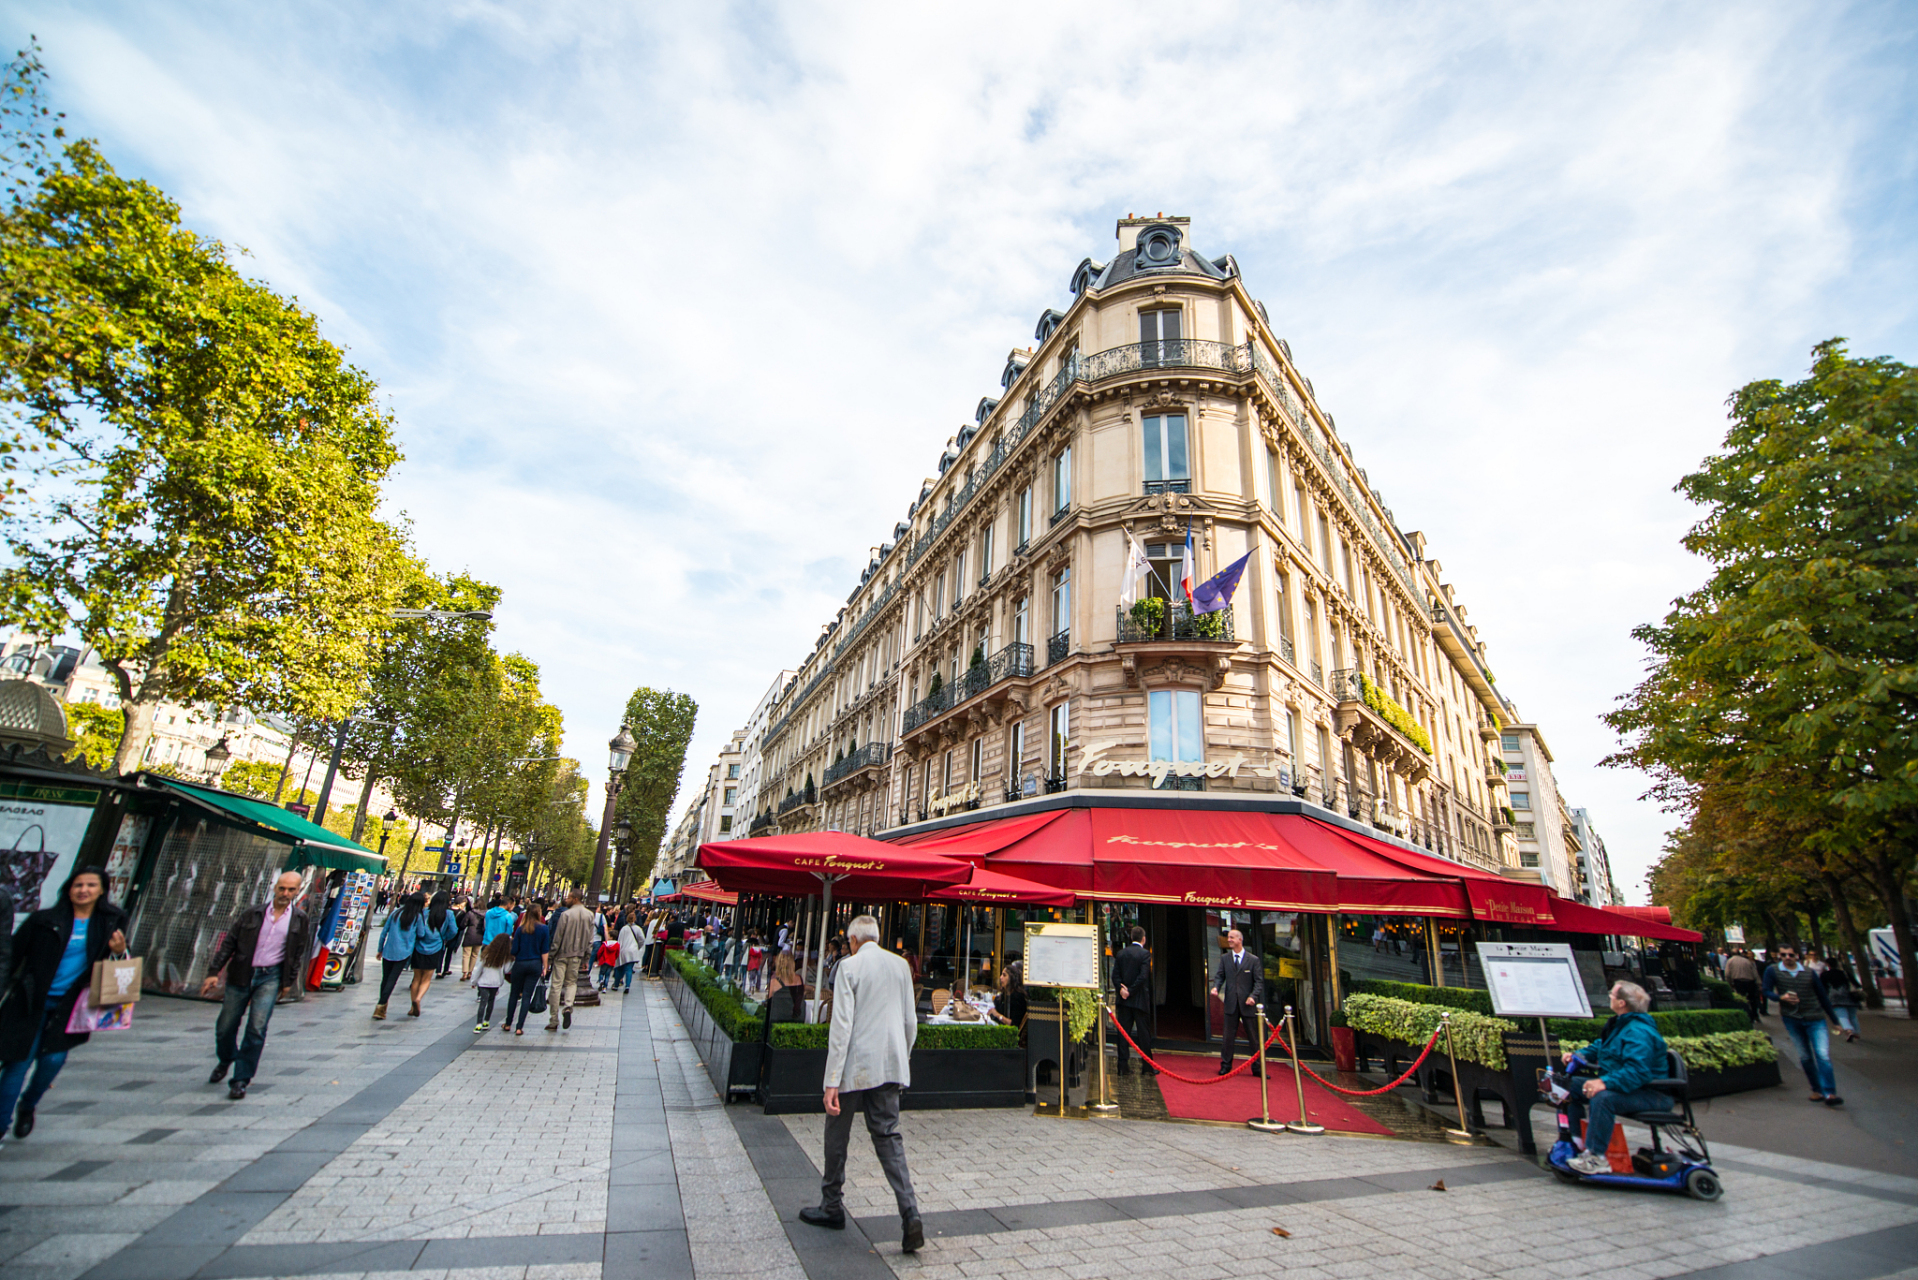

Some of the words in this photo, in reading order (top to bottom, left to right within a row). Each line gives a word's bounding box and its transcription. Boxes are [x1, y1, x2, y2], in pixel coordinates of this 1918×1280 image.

[1078, 742, 1280, 789] Fouquet's
[928, 781, 979, 816] Fouquet's
[451, 864, 458, 872] P
[823, 854, 885, 871] Fouquet's
[1184, 891, 1242, 906] Fouquet's
[1488, 899, 1509, 919] Petite
[1509, 901, 1535, 915] Maison
